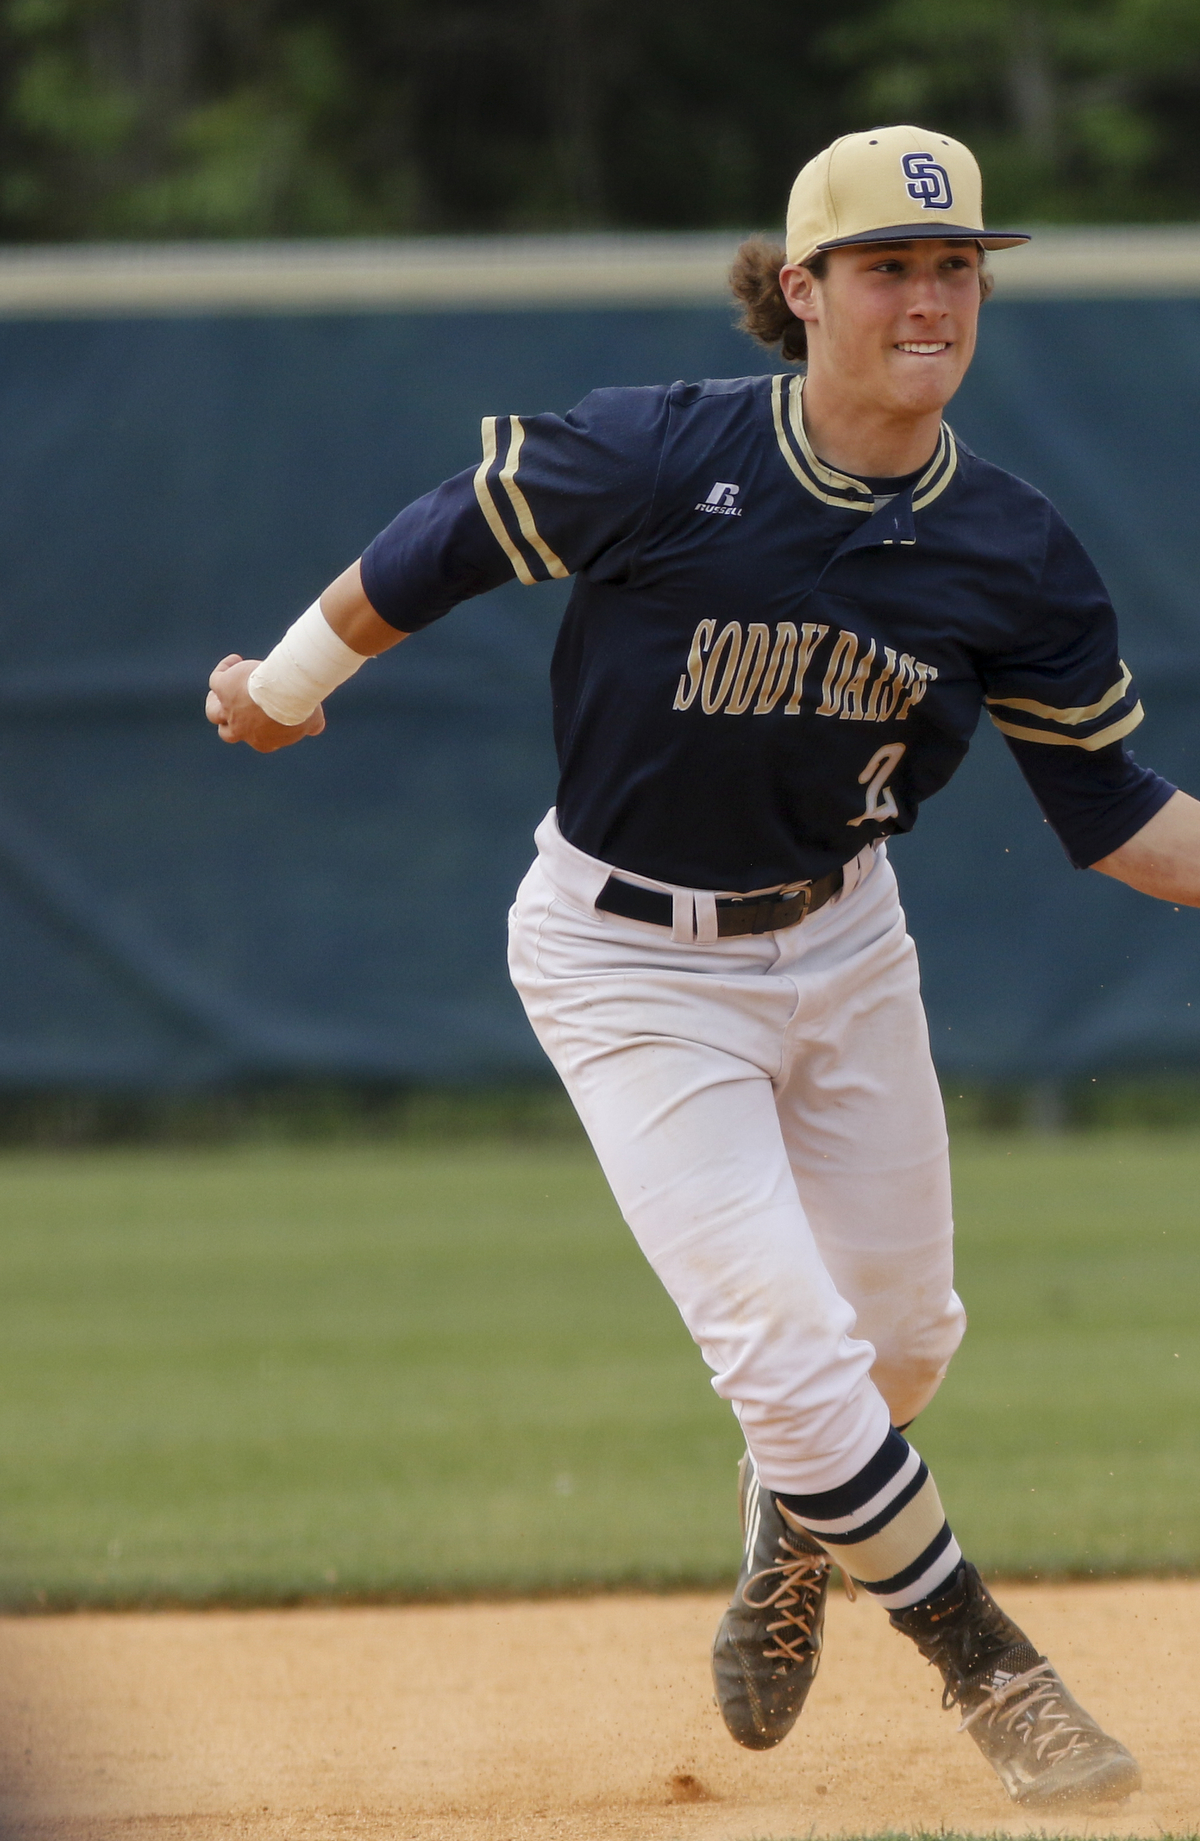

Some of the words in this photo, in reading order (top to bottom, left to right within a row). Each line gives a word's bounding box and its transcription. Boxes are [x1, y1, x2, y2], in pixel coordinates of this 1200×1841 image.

[694, 503, 743, 517] RUSSELL
[672, 617, 830, 716] SODDY
[846, 741, 907, 827] 2
